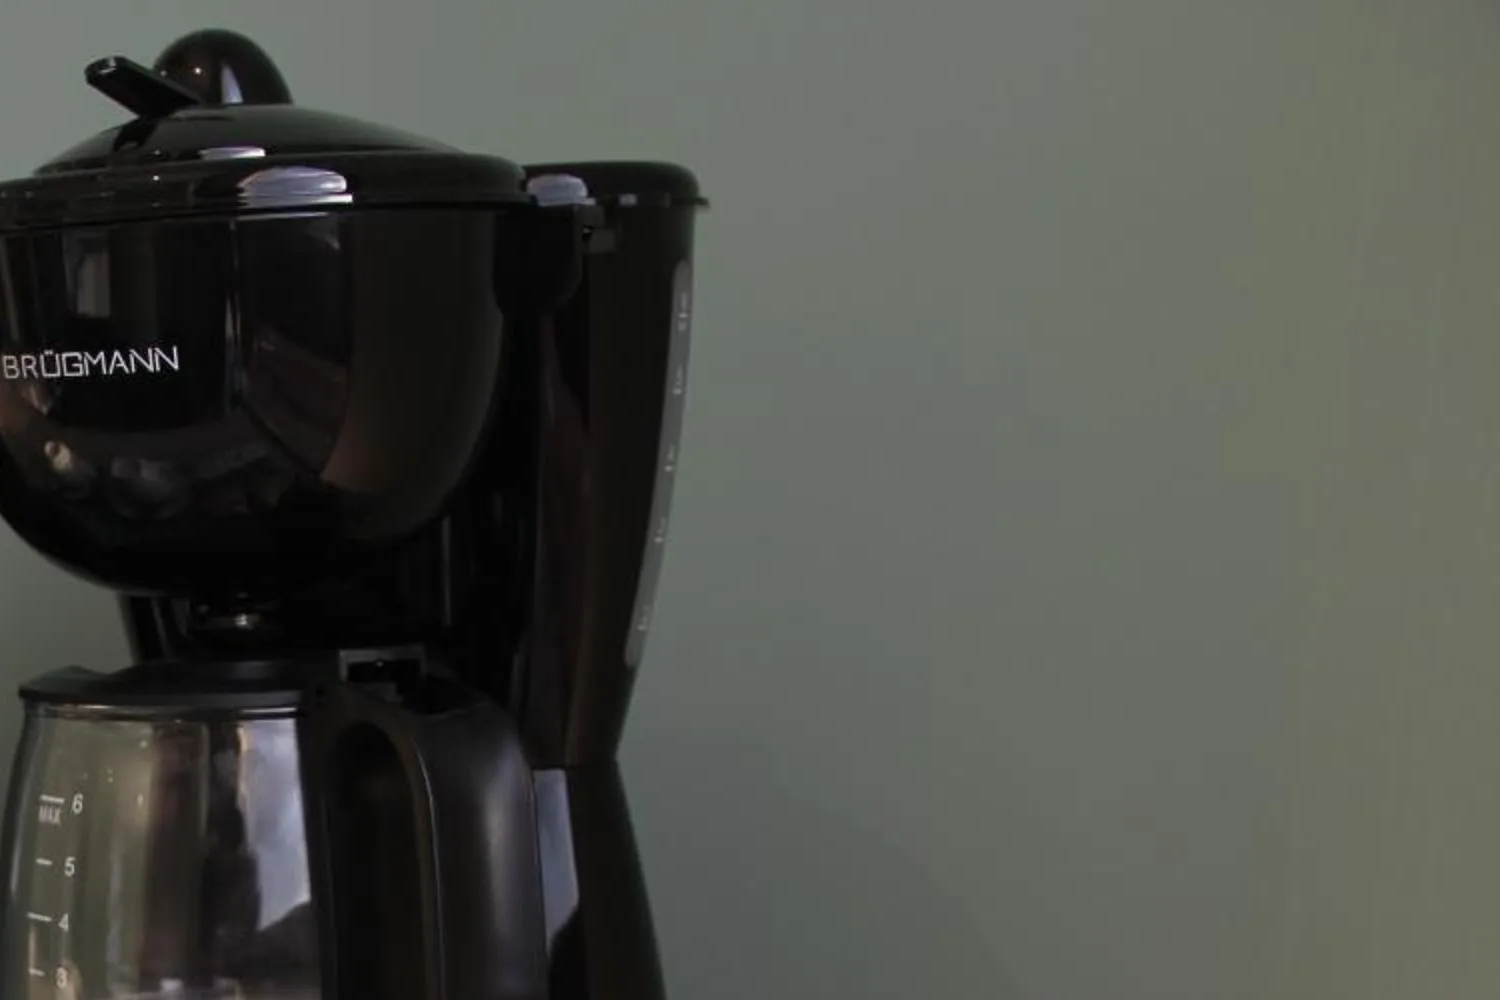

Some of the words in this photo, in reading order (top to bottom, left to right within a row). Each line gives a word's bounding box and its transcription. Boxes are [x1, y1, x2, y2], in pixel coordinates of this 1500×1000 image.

[2, 345, 179, 380] BRÜGMANN
[38, 804, 61, 824] MAX
[71, 793, 83, 815] 6
[63, 856, 75, 877] 5
[58, 912, 69, 932] 4
